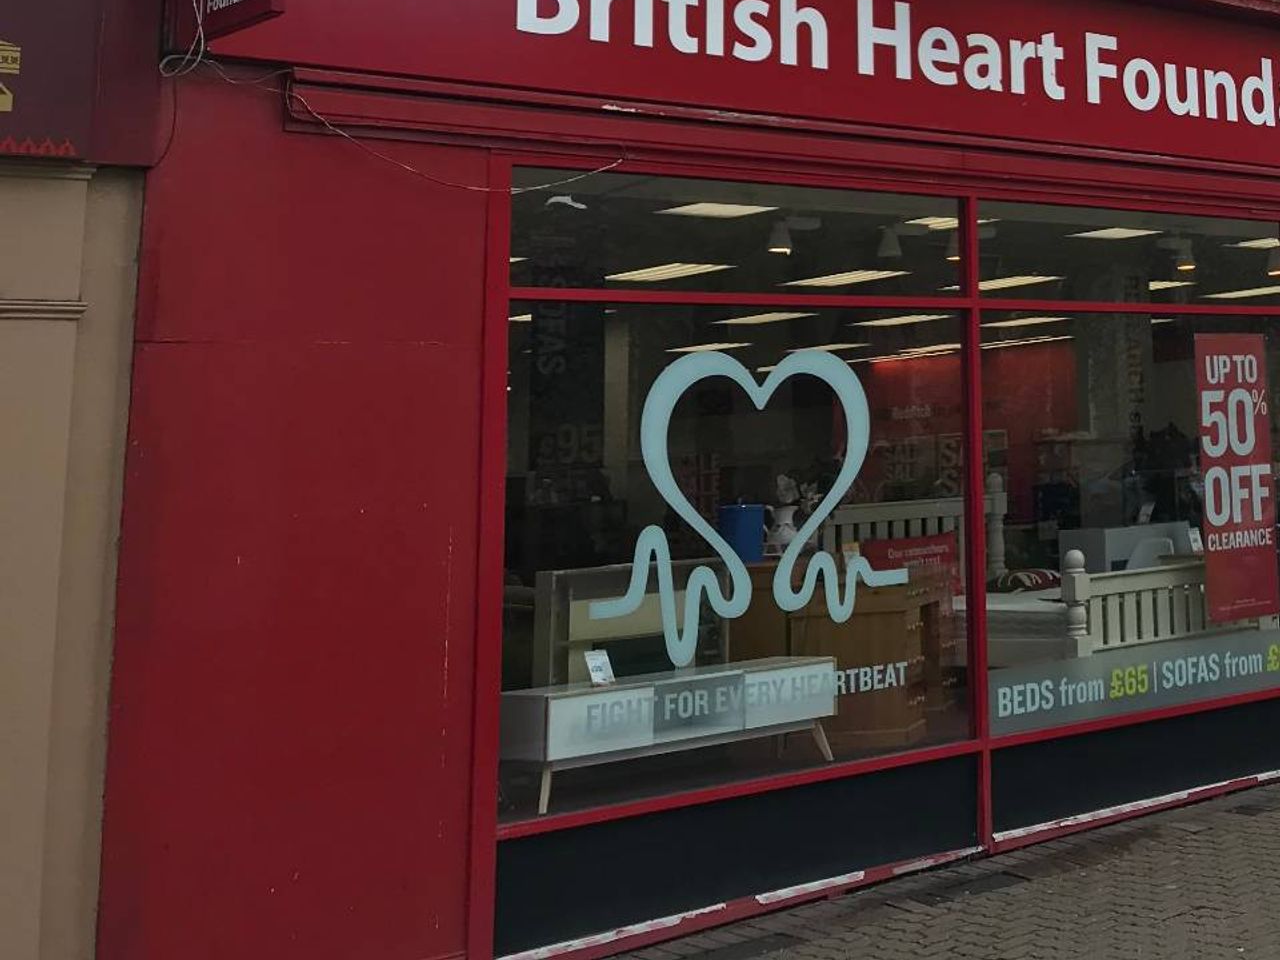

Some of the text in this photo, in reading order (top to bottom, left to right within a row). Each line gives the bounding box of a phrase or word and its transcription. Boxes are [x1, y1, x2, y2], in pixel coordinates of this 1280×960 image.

[1204, 354, 1258, 385] UP TO
[1201, 387, 1267, 458] 50%
[1203, 463, 1272, 528] OFF
[1207, 527, 1273, 552] CLEARANCE
[585, 660, 909, 733] FIGHT FOR EVERY HEARTBEAT
[998, 679, 1055, 718] BEDS
[1059, 677, 1105, 708] from
[1109, 664, 1150, 700] £65
[1162, 652, 1222, 690] SOFAS
[1223, 650, 1263, 679] from
